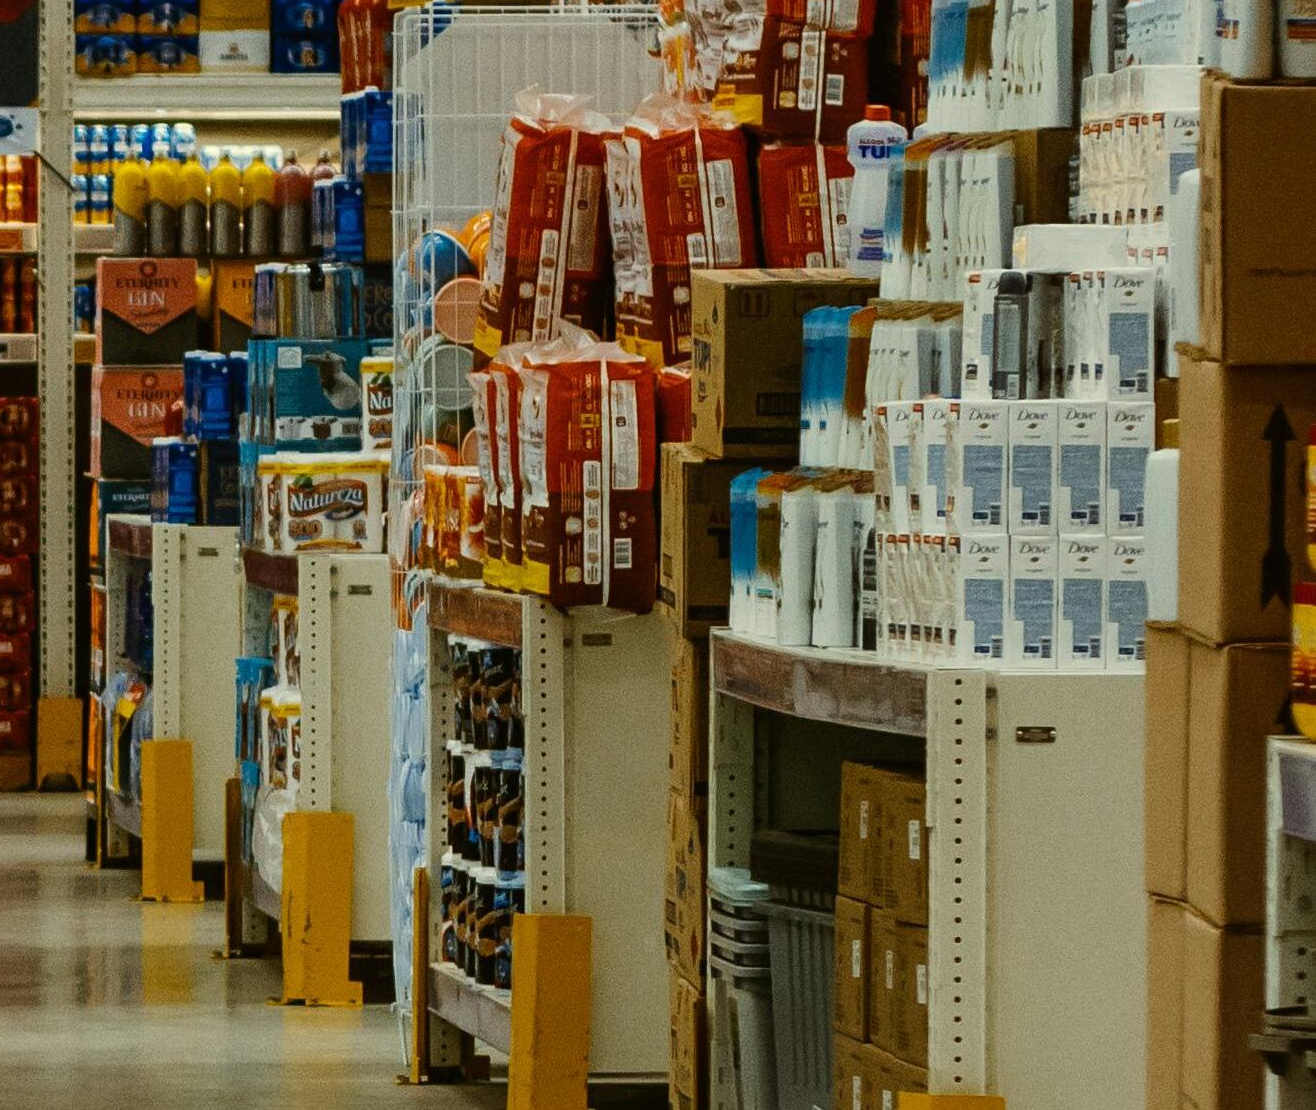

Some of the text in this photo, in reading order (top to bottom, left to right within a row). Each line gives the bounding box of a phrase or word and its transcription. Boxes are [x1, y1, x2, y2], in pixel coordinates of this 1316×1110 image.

[1112, 271, 1145, 289] Dove
[968, 408, 1001, 423] Dove
[1065, 408, 1097, 422] Dove
[1114, 411, 1146, 424] Dove
[290, 487, 364, 512] Natureza
[968, 541, 1001, 557] Dove
[1067, 542, 1100, 556] Dove
